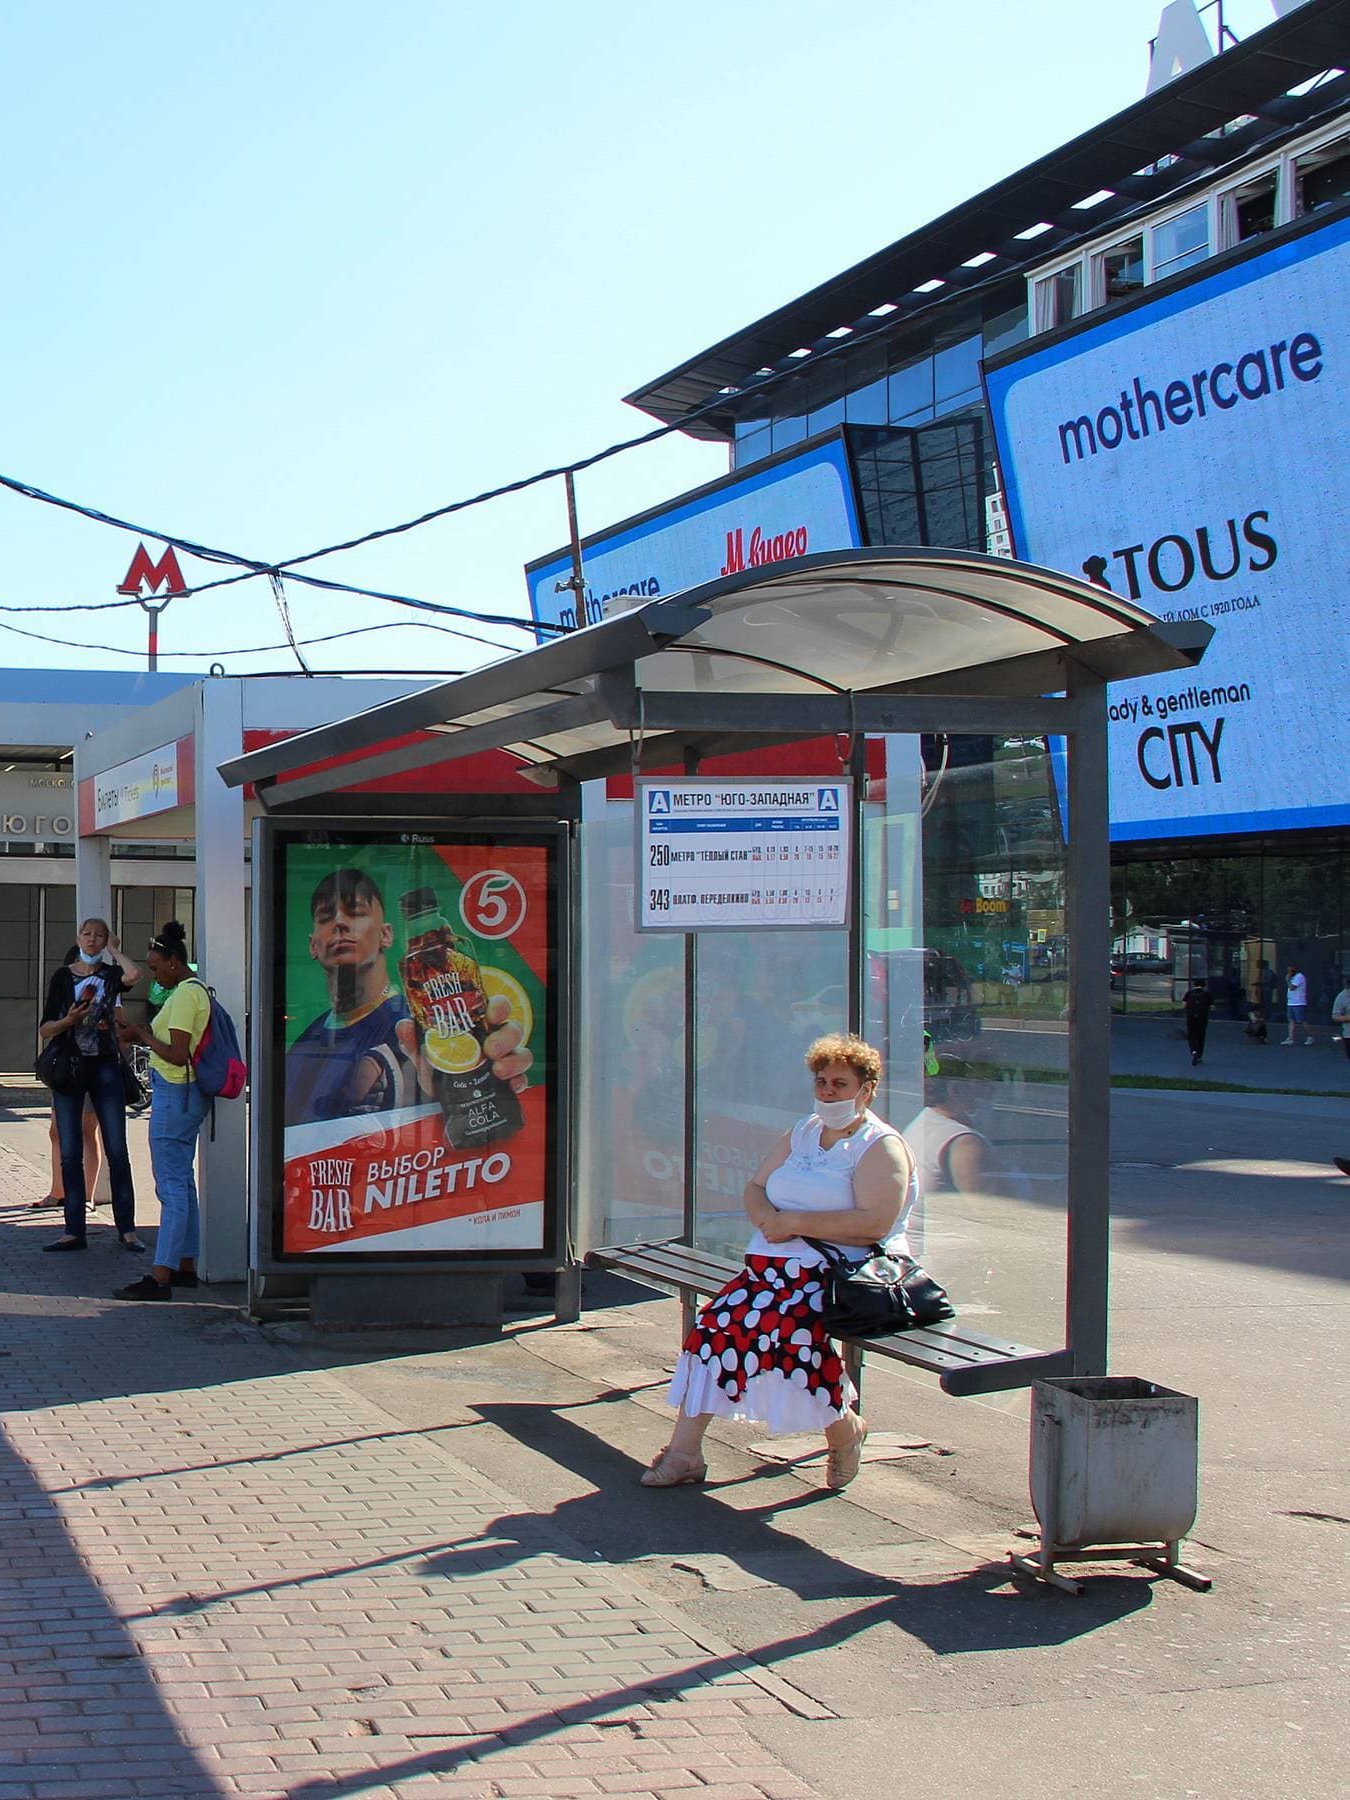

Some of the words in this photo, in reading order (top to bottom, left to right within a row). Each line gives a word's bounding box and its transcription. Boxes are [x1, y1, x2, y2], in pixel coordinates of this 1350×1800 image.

[1058, 332, 1324, 464] mothercare
[1112, 511, 1278, 600] TOUS
[1210, 600, 1231, 616] 1920
[1231, 595, 1261, 612] ГОДА
[1107, 698, 1138, 723] ady
[1141, 695, 1154, 716] &
[1156, 683, 1251, 719] gentleman
[1137, 717, 1226, 790] CITY
[673, 793, 712, 807] МЕТРО
[411, 833, 436, 844] Russ
[650, 844, 670, 867] 250
[670, 851, 695, 862] МЕТРО
[650, 888, 670, 911] 343
[422, 971, 464, 1004] FRESH
[431, 996, 477, 1039] BAR
[468, 1101, 497, 1118] ALFA
[468, 1111, 501, 1128] COLA
[308, 1159, 353, 1187] FRESH
[366, 1146, 445, 1182] ВЫБОР
[363, 1152, 511, 1214] NILETTO
[306, 1188, 354, 1233] BAR
